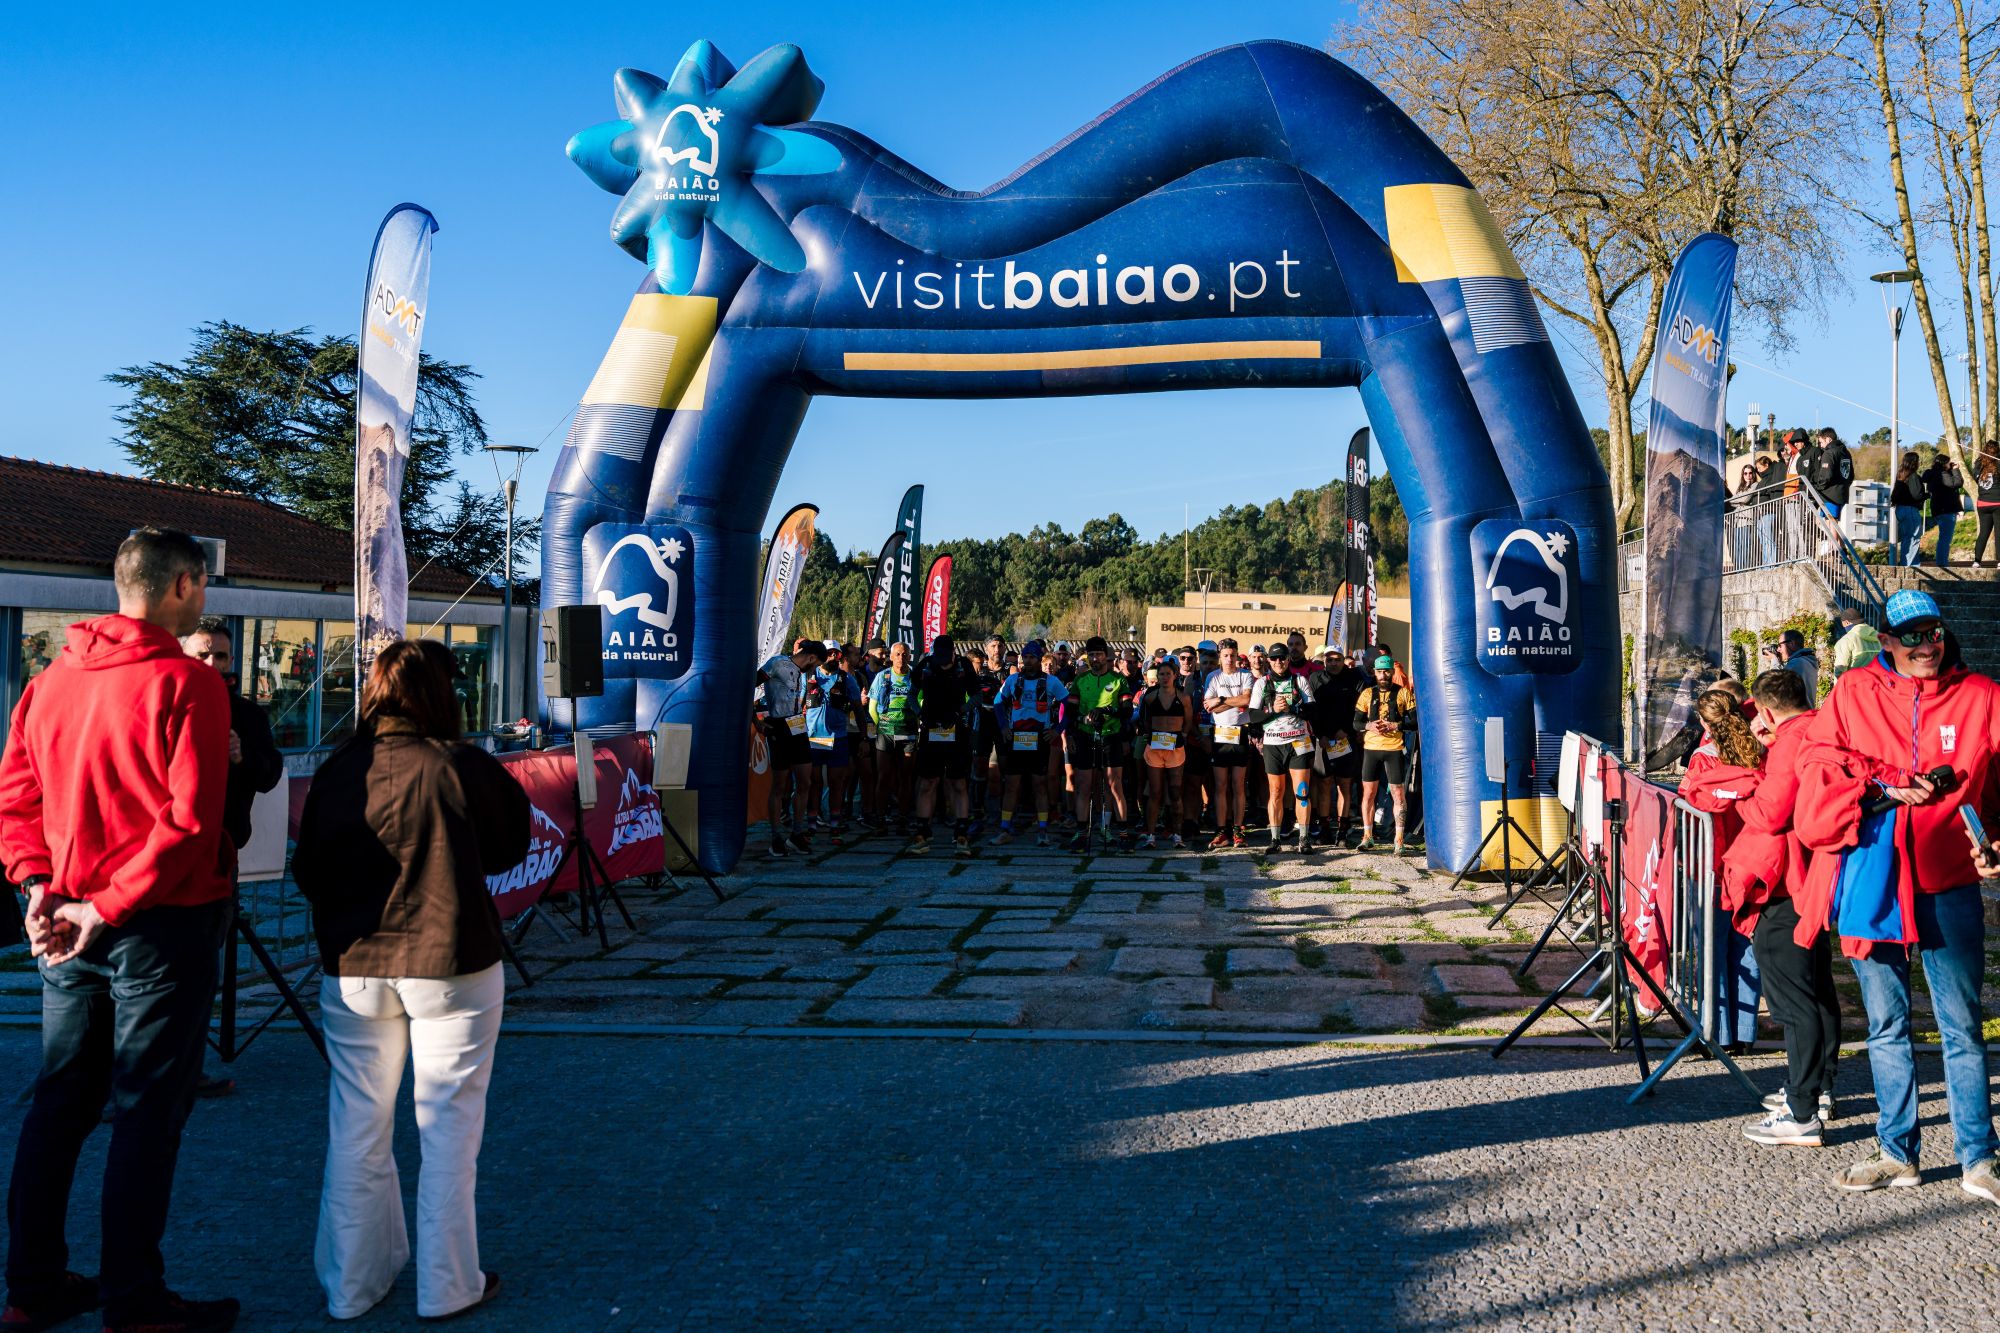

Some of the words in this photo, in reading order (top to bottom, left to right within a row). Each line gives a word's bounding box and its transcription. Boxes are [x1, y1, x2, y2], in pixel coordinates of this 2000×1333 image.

[655, 174, 719, 190] BAIÃO
[654, 191, 675, 201] vida
[679, 192, 720, 202] natural
[853, 249, 1301, 312] visitbaiao.pt
[898, 508, 917, 661] ERRELL
[1161, 623, 1226, 633] BOMBEIROS
[1229, 624, 1306, 636] VOLUNTÁRIOS
[1309, 627, 1324, 636] DE
[1487, 623, 1571, 642] BAIÃO
[608, 629, 678, 648] AIÃO
[602, 649, 618, 660] da
[623, 650, 678, 662] natural
[1488, 645, 1517, 656] vida
[1521, 644, 1572, 656] natural
[529, 837, 542, 852] AIL
